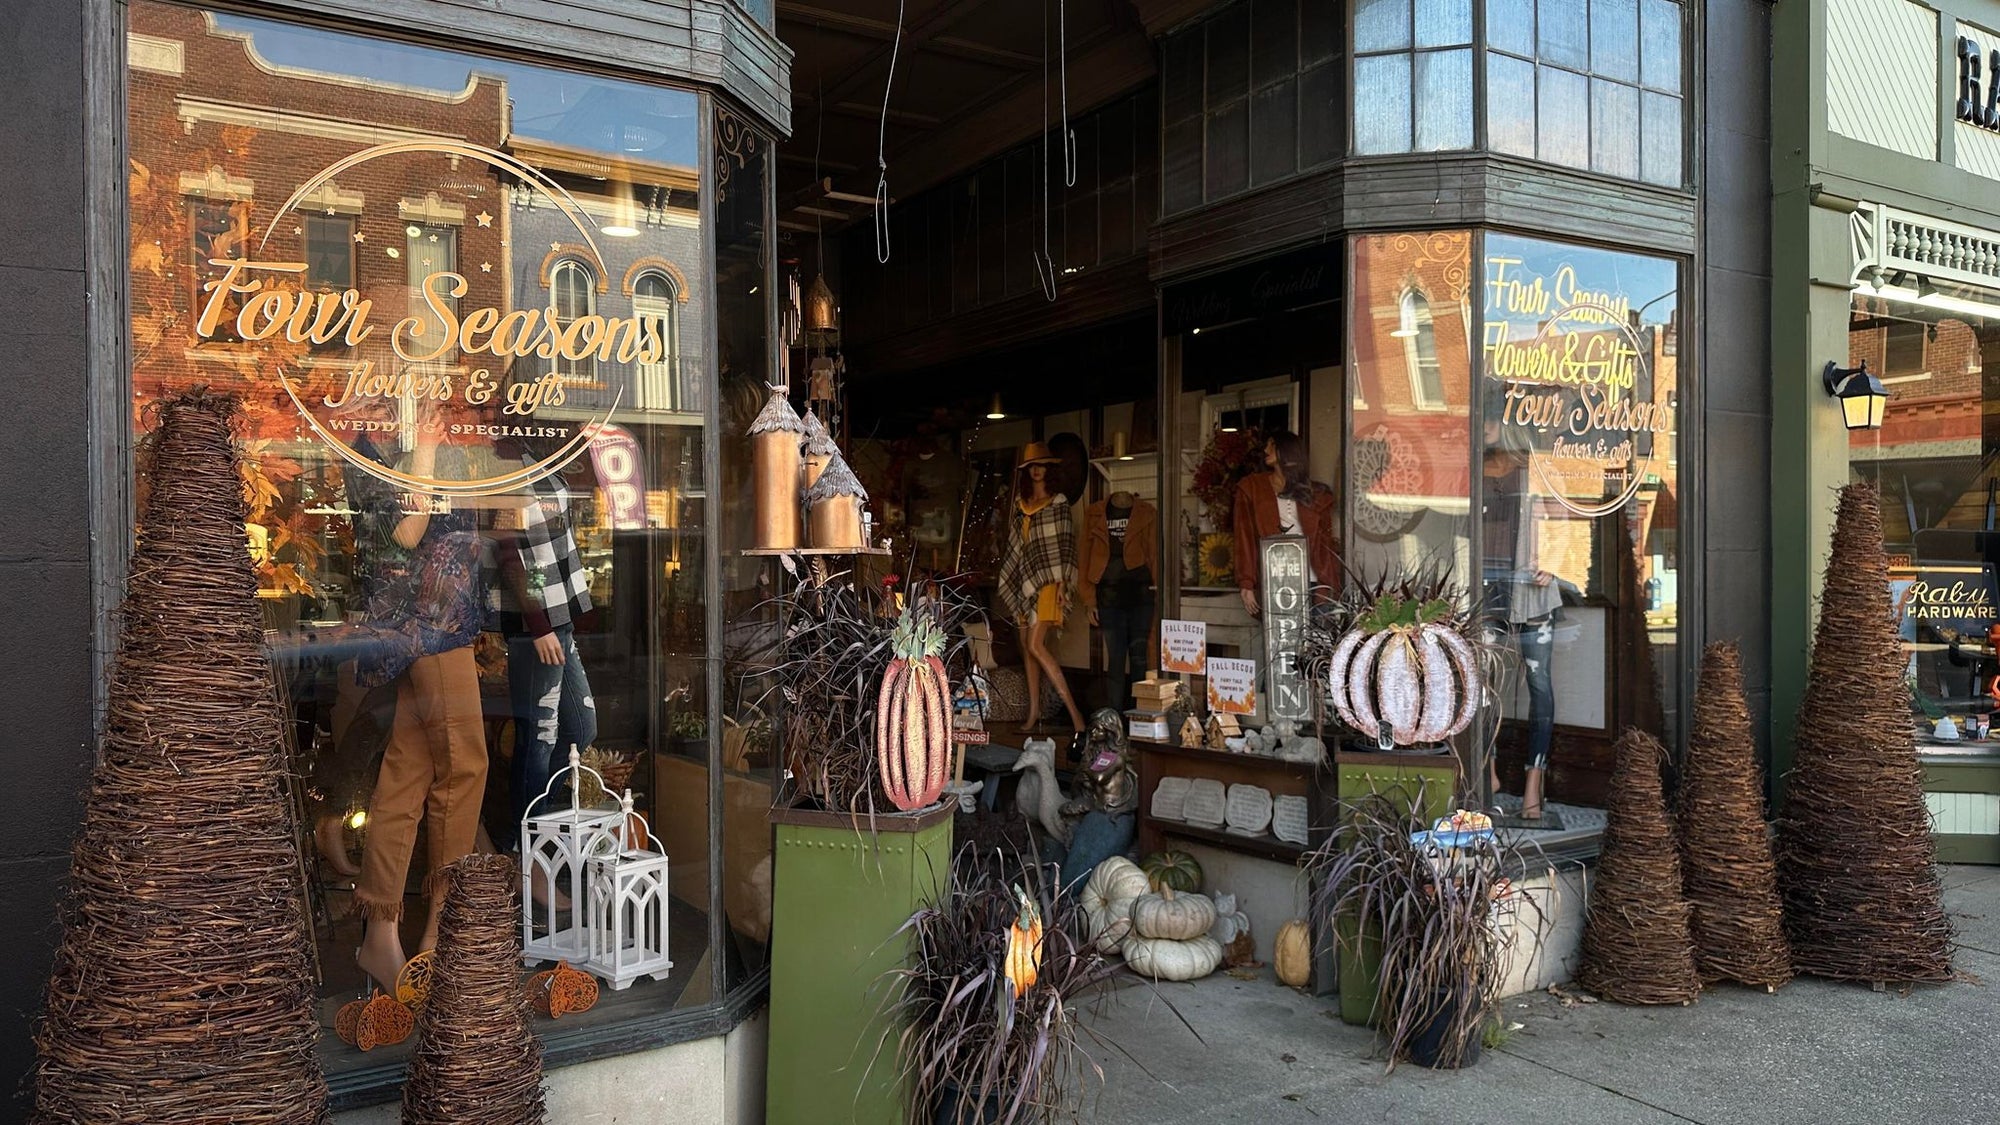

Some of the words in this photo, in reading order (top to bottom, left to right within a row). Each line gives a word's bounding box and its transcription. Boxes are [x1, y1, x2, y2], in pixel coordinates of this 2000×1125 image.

[1486, 257, 1550, 315] Four
[1551, 266, 1630, 326] Seasons
[197, 258, 375, 347] Four
[392, 272, 663, 365] Seasons
[1483, 321, 1557, 382] Flowers
[1583, 335, 1637, 411] Gifts
[324, 361, 453, 407] flowers
[465, 369, 499, 405] &
[503, 372, 567, 415] gifts
[1502, 379, 1564, 427] Four
[1569, 383, 1668, 436] Seasons
[329, 419, 437, 436] WEDDING
[450, 424, 570, 439] SPECIALIST
[1546, 436, 1592, 465] flowers
[1595, 439, 1607, 461] &
[1608, 439, 1633, 467] gifts
[1905, 580, 1989, 612] Raby
[1907, 605, 1998, 619] HARDWARE
[1165, 624, 1181, 633] FALL
[1184, 624, 1204, 635] DECOR
[1275, 586, 1303, 709] OPEN
[1211, 662, 1228, 671] FALL
[1232, 662, 1253, 674] DECOR
[953, 732, 986, 742] SSINGS
